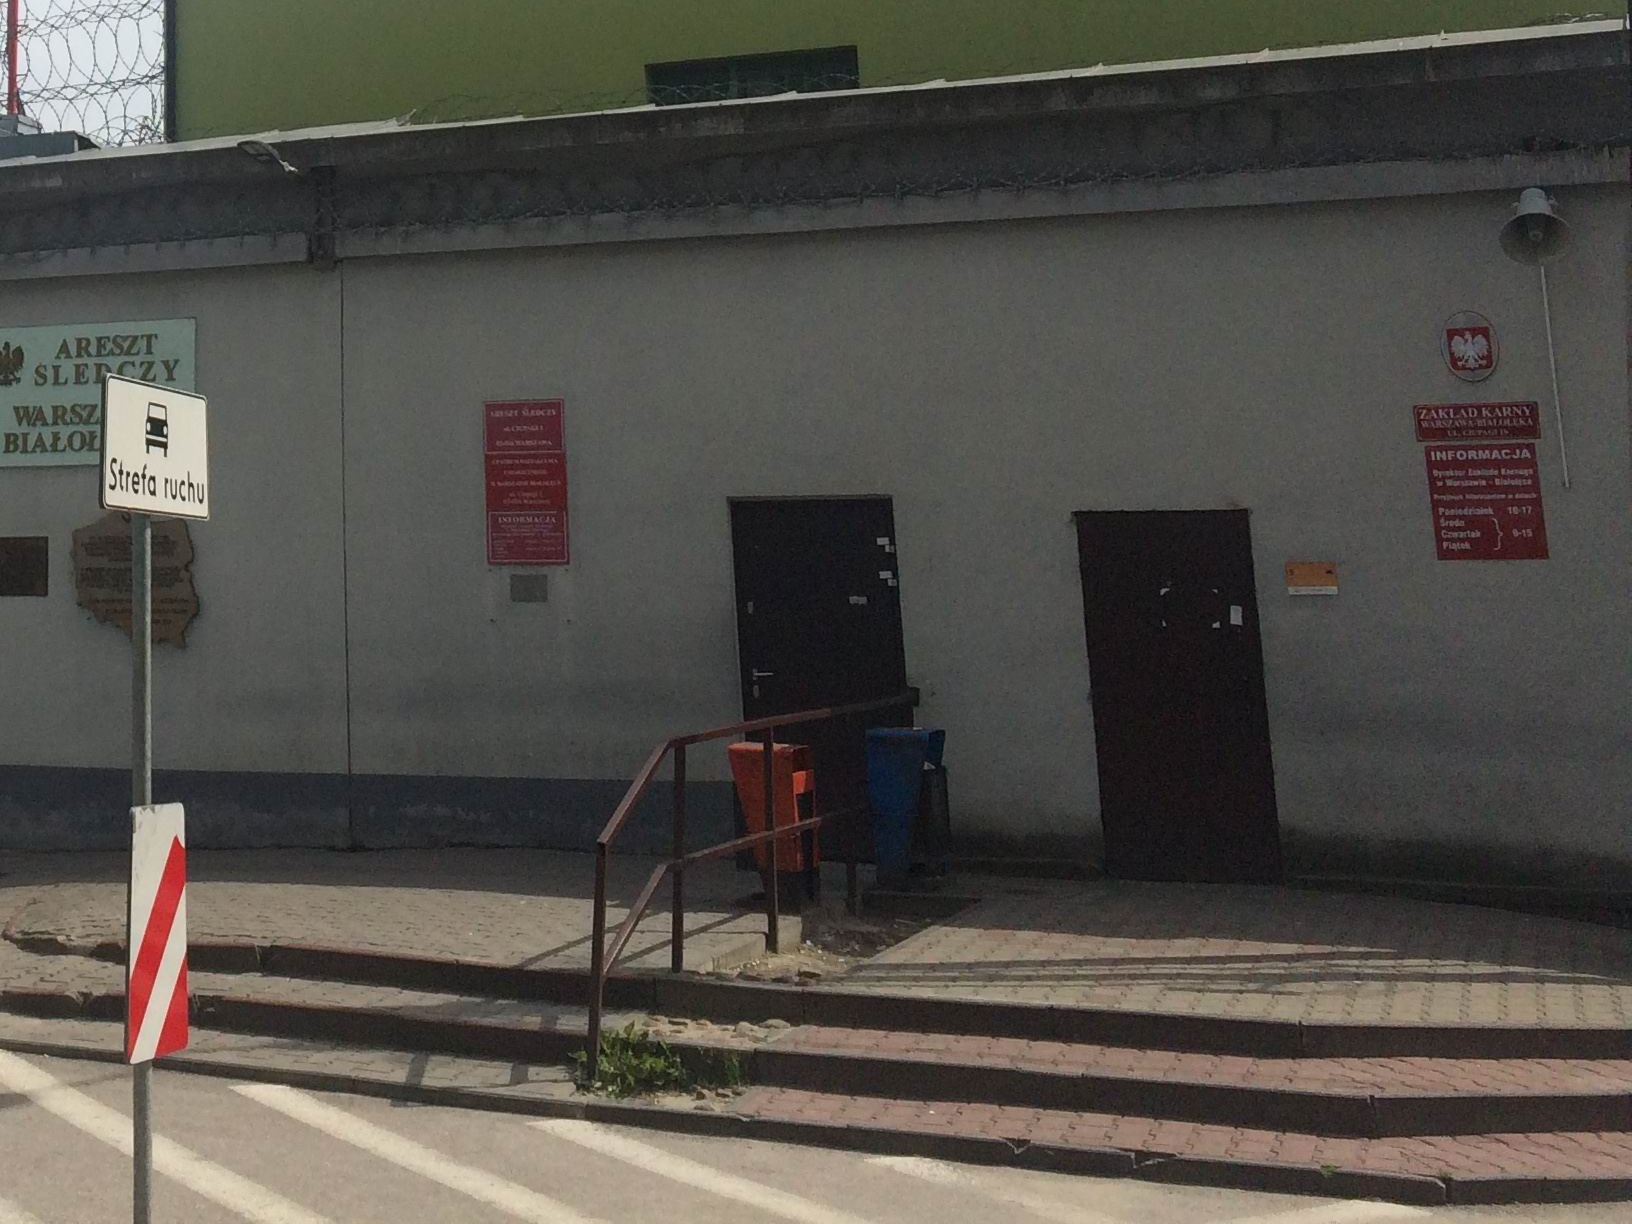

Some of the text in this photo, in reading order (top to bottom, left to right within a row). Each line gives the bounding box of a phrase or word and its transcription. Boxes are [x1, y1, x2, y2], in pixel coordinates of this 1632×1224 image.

[55, 333, 158, 360] ARESZT
[13, 403, 101, 427] WARSZ
[1482, 406, 1532, 418] KARNY
[3, 430, 100, 454] BIAŁOŁ
[1430, 449, 1532, 461] INFORMACJA
[109, 457, 205, 504] Strefa ruchu
